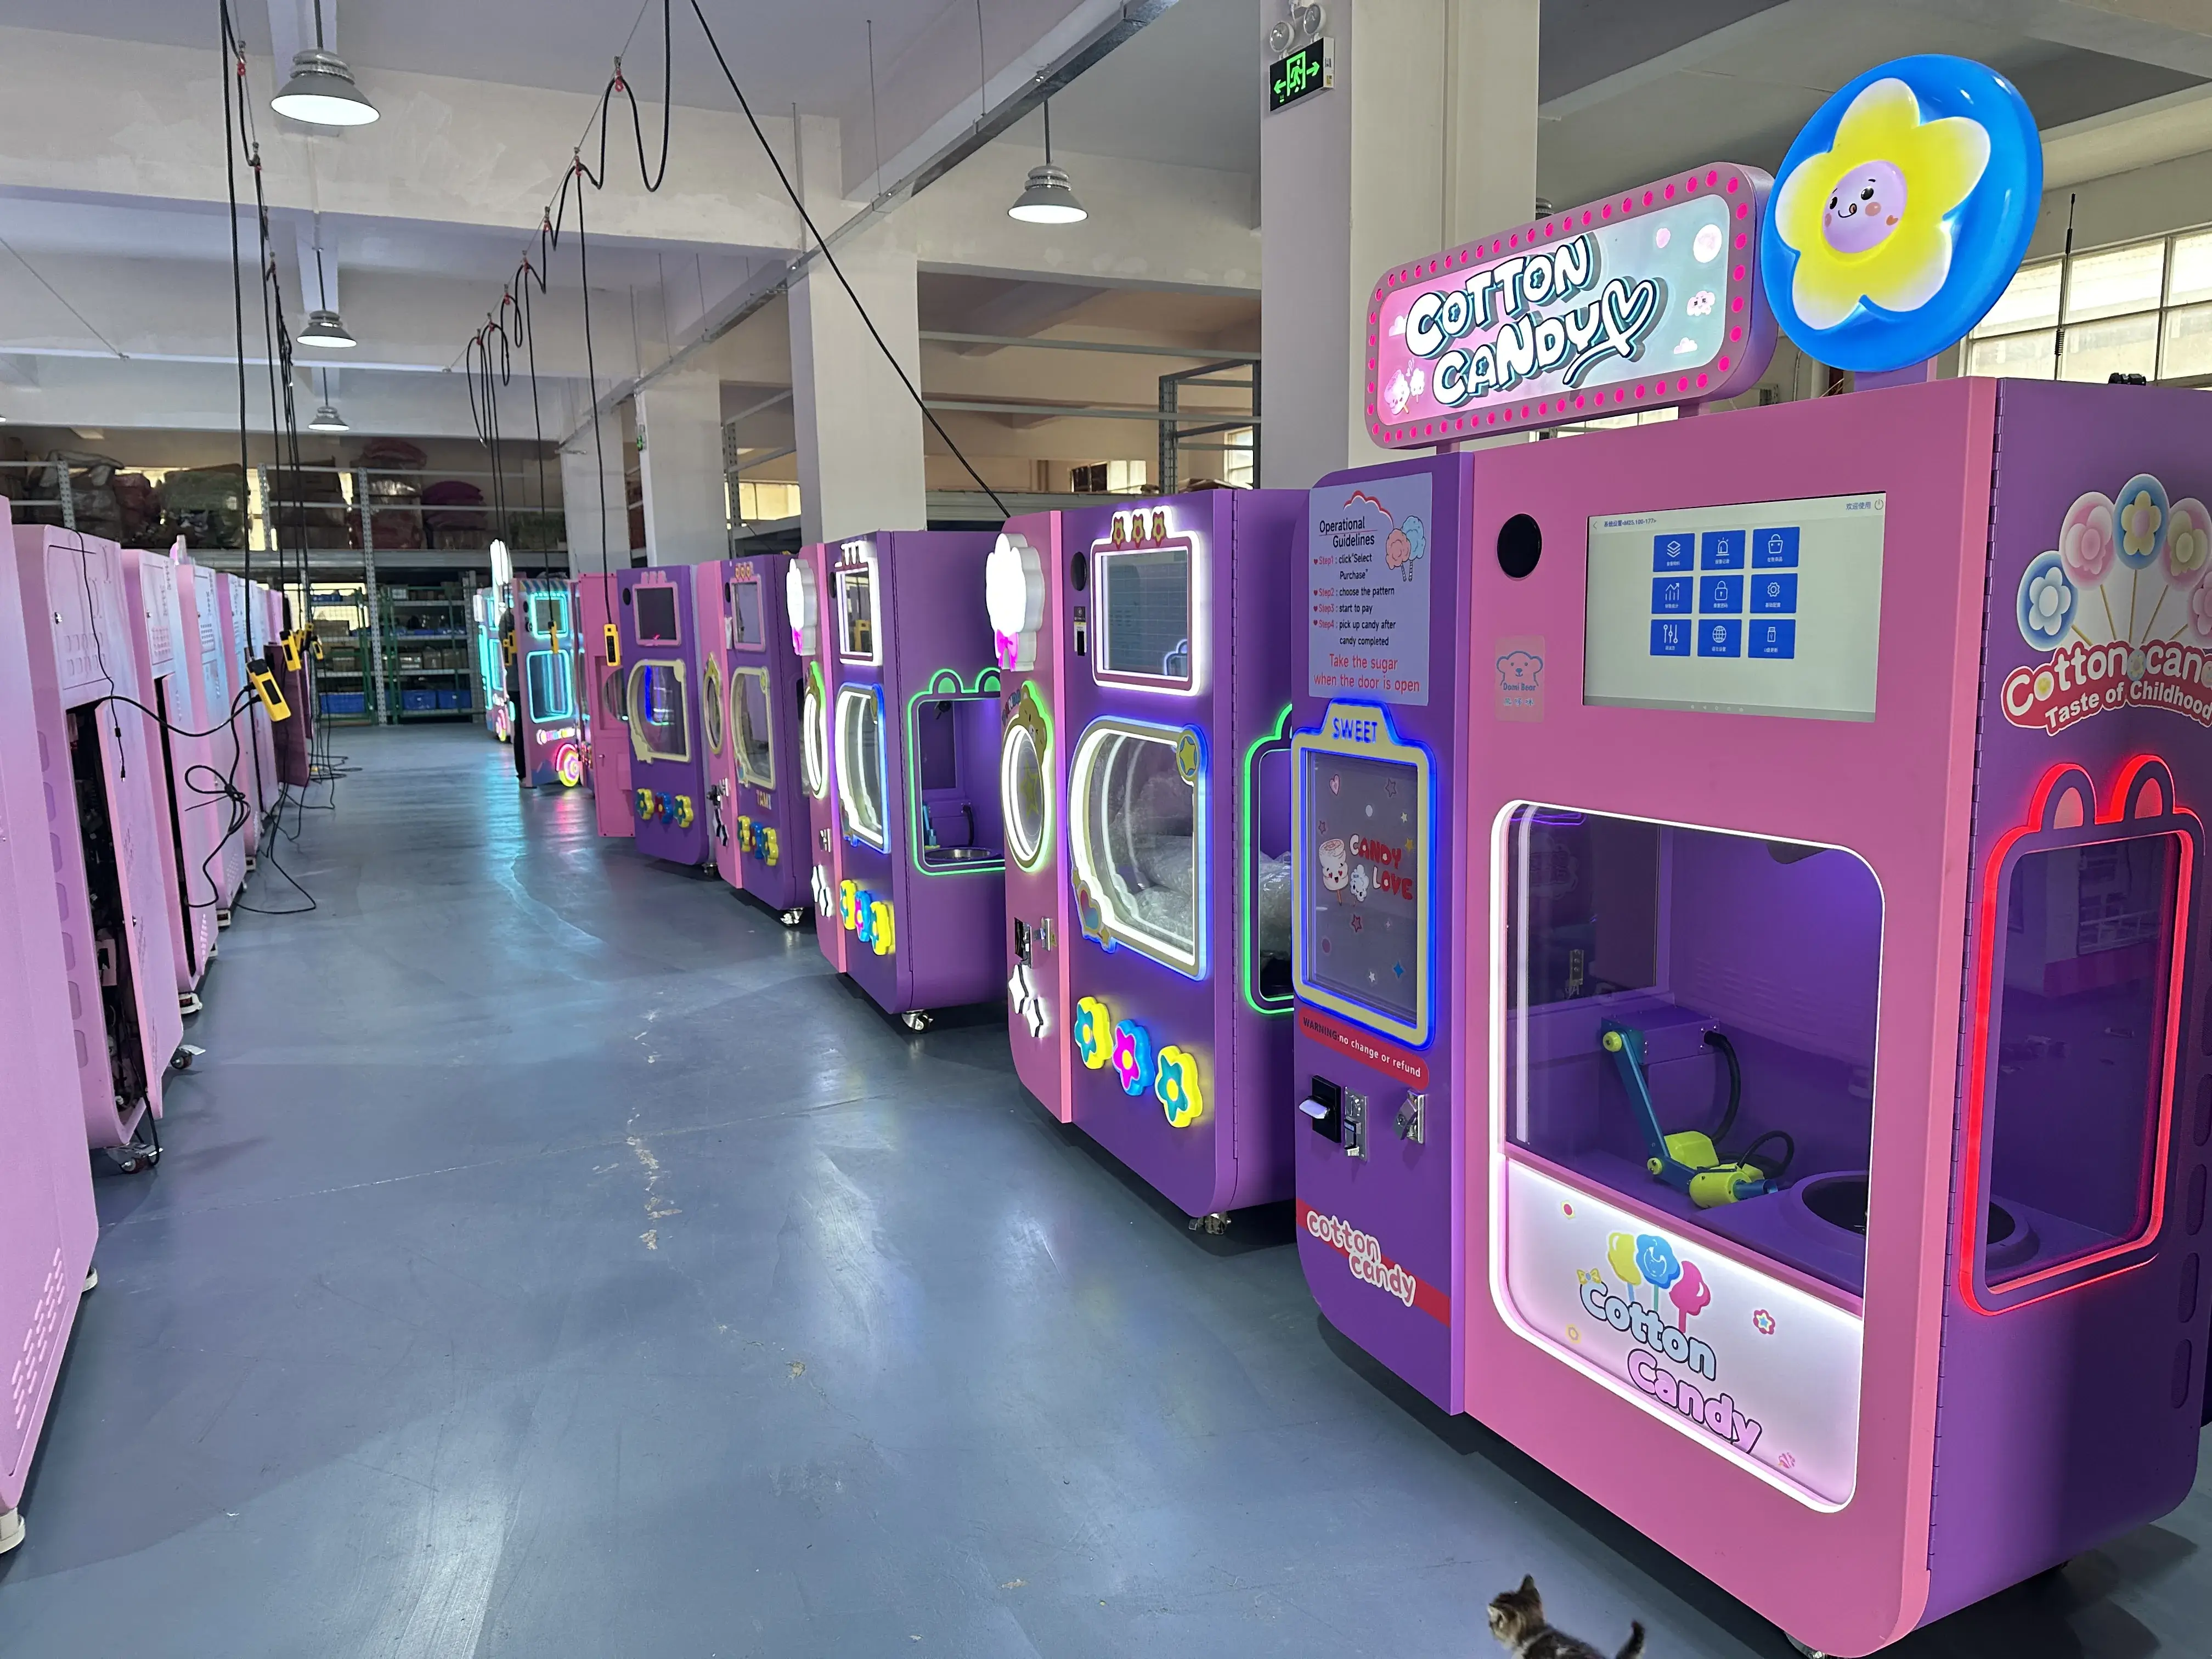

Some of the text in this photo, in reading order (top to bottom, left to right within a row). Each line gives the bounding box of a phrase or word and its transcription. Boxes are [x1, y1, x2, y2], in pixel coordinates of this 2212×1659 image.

[1405, 234, 1593, 358] COTTON
[1432, 299, 1603, 406] CANDY
[1319, 516, 1365, 535] Operational
[1333, 534, 1375, 548] Guidelines
[1339, 587, 1359, 596] choose
[1361, 586, 1370, 595] the
[1373, 586, 1395, 598] pattern
[1339, 603, 1353, 613] start
[1355, 604, 1361, 612] to
[1362, 605, 1373, 614] pay
[1339, 619, 1351, 630] pick
[1352, 622, 1360, 630] up
[1362, 620, 1379, 631] candy
[1381, 619, 1396, 629] after
[1339, 636, 1389, 647] candy completed
[1329, 653, 1398, 673] Take the sugar
[2006, 646, 2128, 716] Cotton
[1313, 672, 1420, 695] when the door is open
[2045, 692, 2100, 729] Taste
[2105, 681, 2124, 703] of
[1331, 716, 1378, 744] SWEET
[1349, 833, 1402, 870] CANDY
[1373, 865, 1413, 900] LOVE
[1351, 1040, 1379, 1059] change
[1381, 1054, 1390, 1063] or
[1393, 1058, 1421, 1077] refund
[1308, 1211, 1381, 1263] cotton
[1350, 1255, 1416, 1307] candy
[1579, 1279, 1717, 1381] Cotton
[1627, 1348, 1763, 1454] Candy
